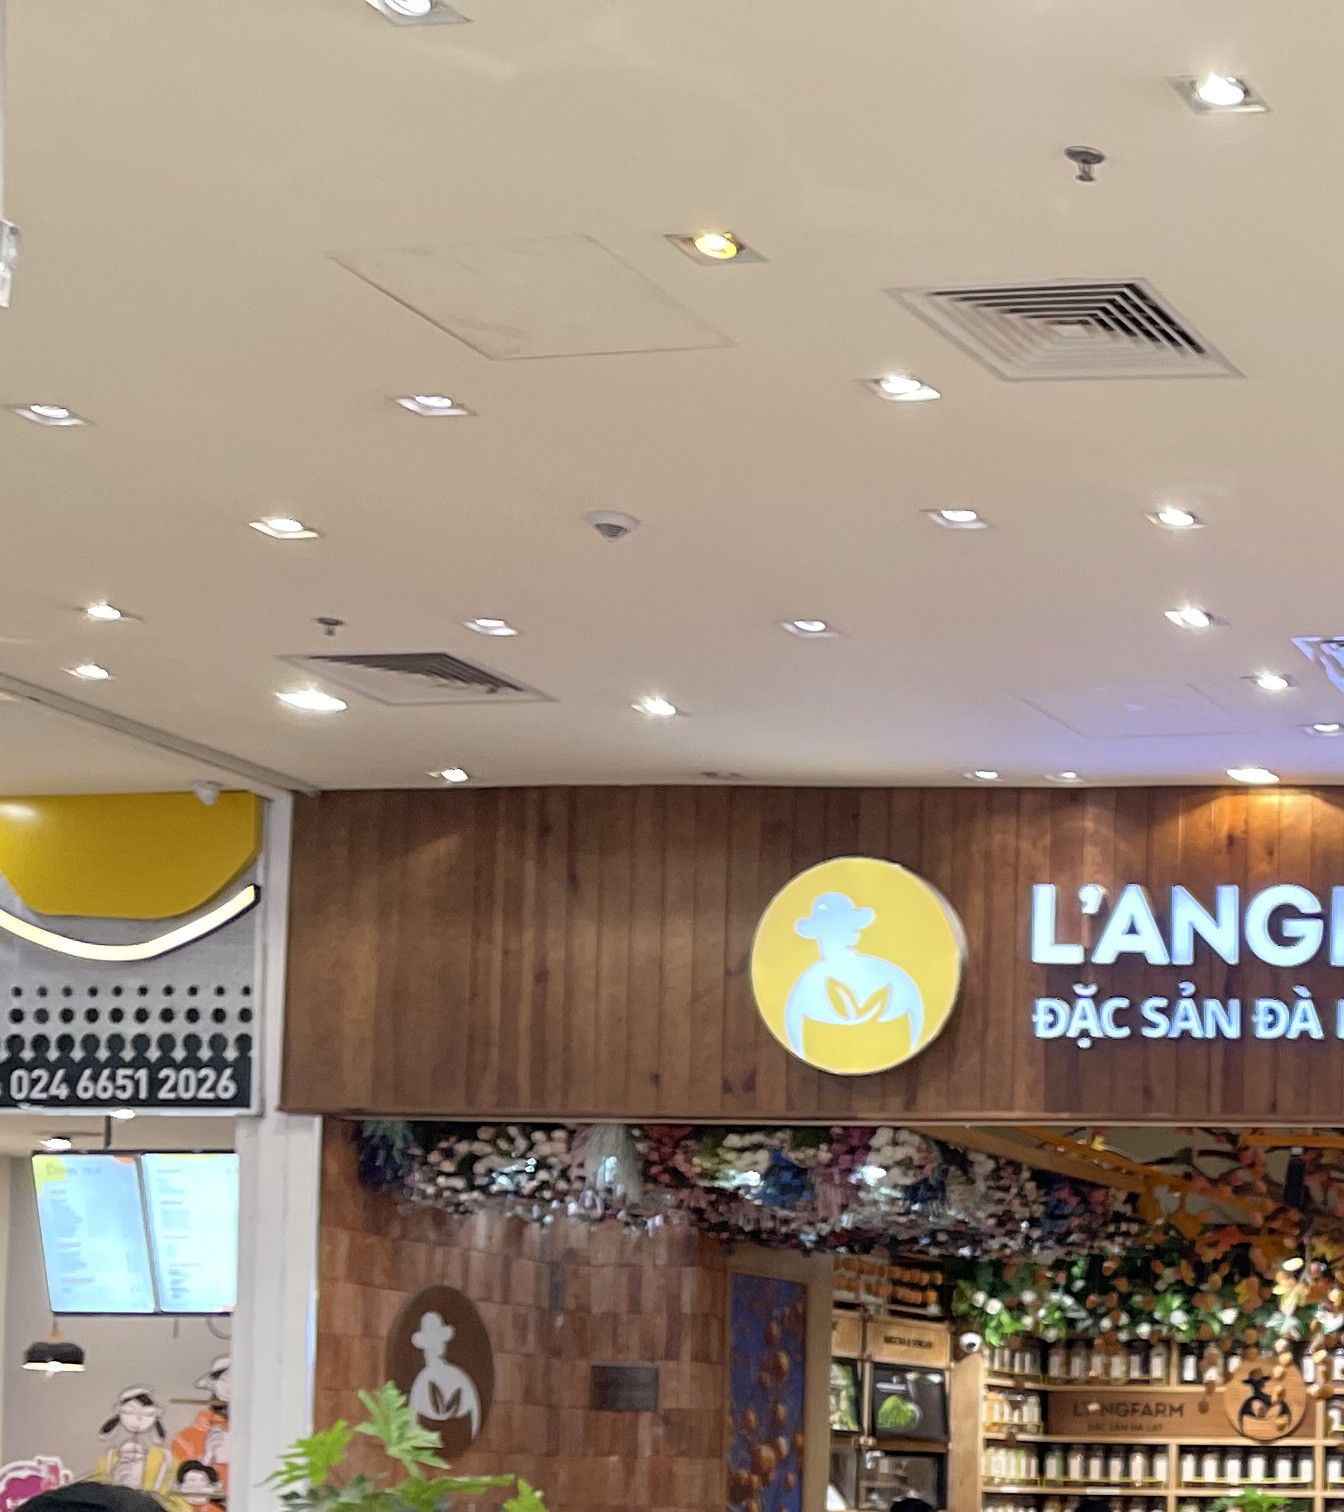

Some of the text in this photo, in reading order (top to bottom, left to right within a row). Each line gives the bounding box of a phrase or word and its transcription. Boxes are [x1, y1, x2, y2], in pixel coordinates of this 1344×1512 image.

[1031, 982, 1131, 1049] ĐẶC
[1140, 980, 1242, 1040] SẢN
[1251, 984, 1325, 1040] ĐÀ
[9, 1066, 238, 1100] 024 6651 2026
